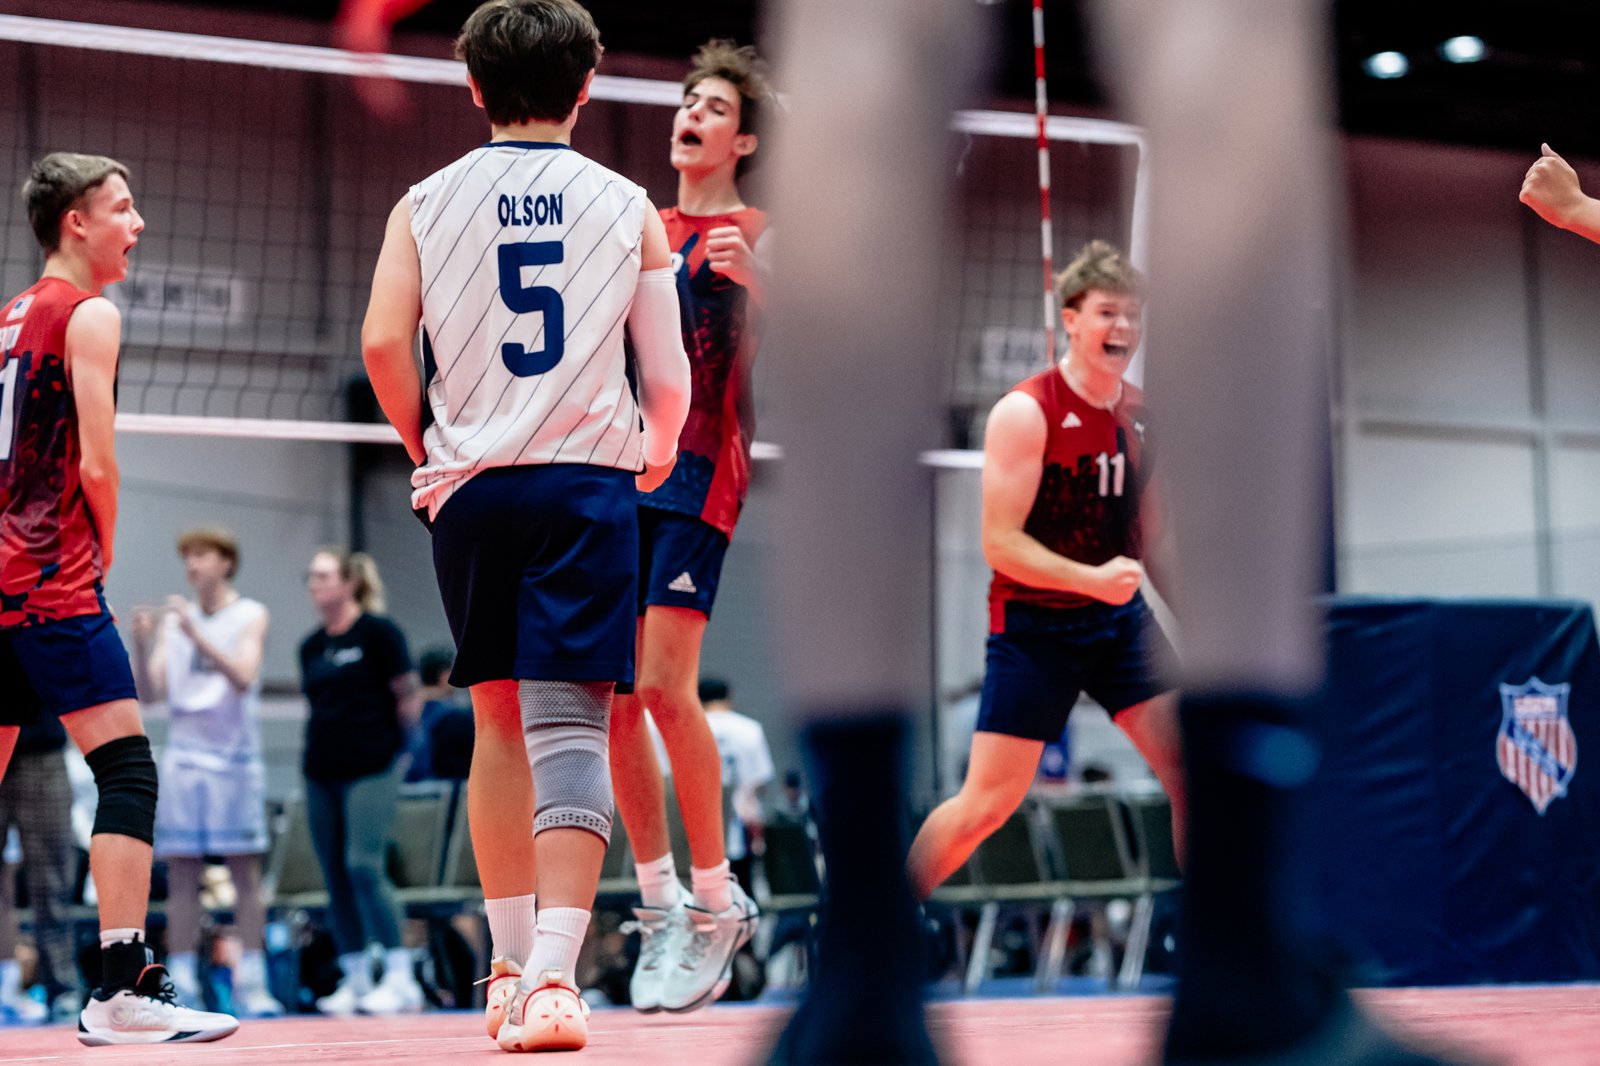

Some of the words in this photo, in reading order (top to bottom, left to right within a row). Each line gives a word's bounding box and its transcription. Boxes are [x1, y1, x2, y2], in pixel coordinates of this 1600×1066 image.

[498, 192, 563, 227] OLSON
[498, 241, 564, 377] 5
[1095, 452, 1125, 497] 11
